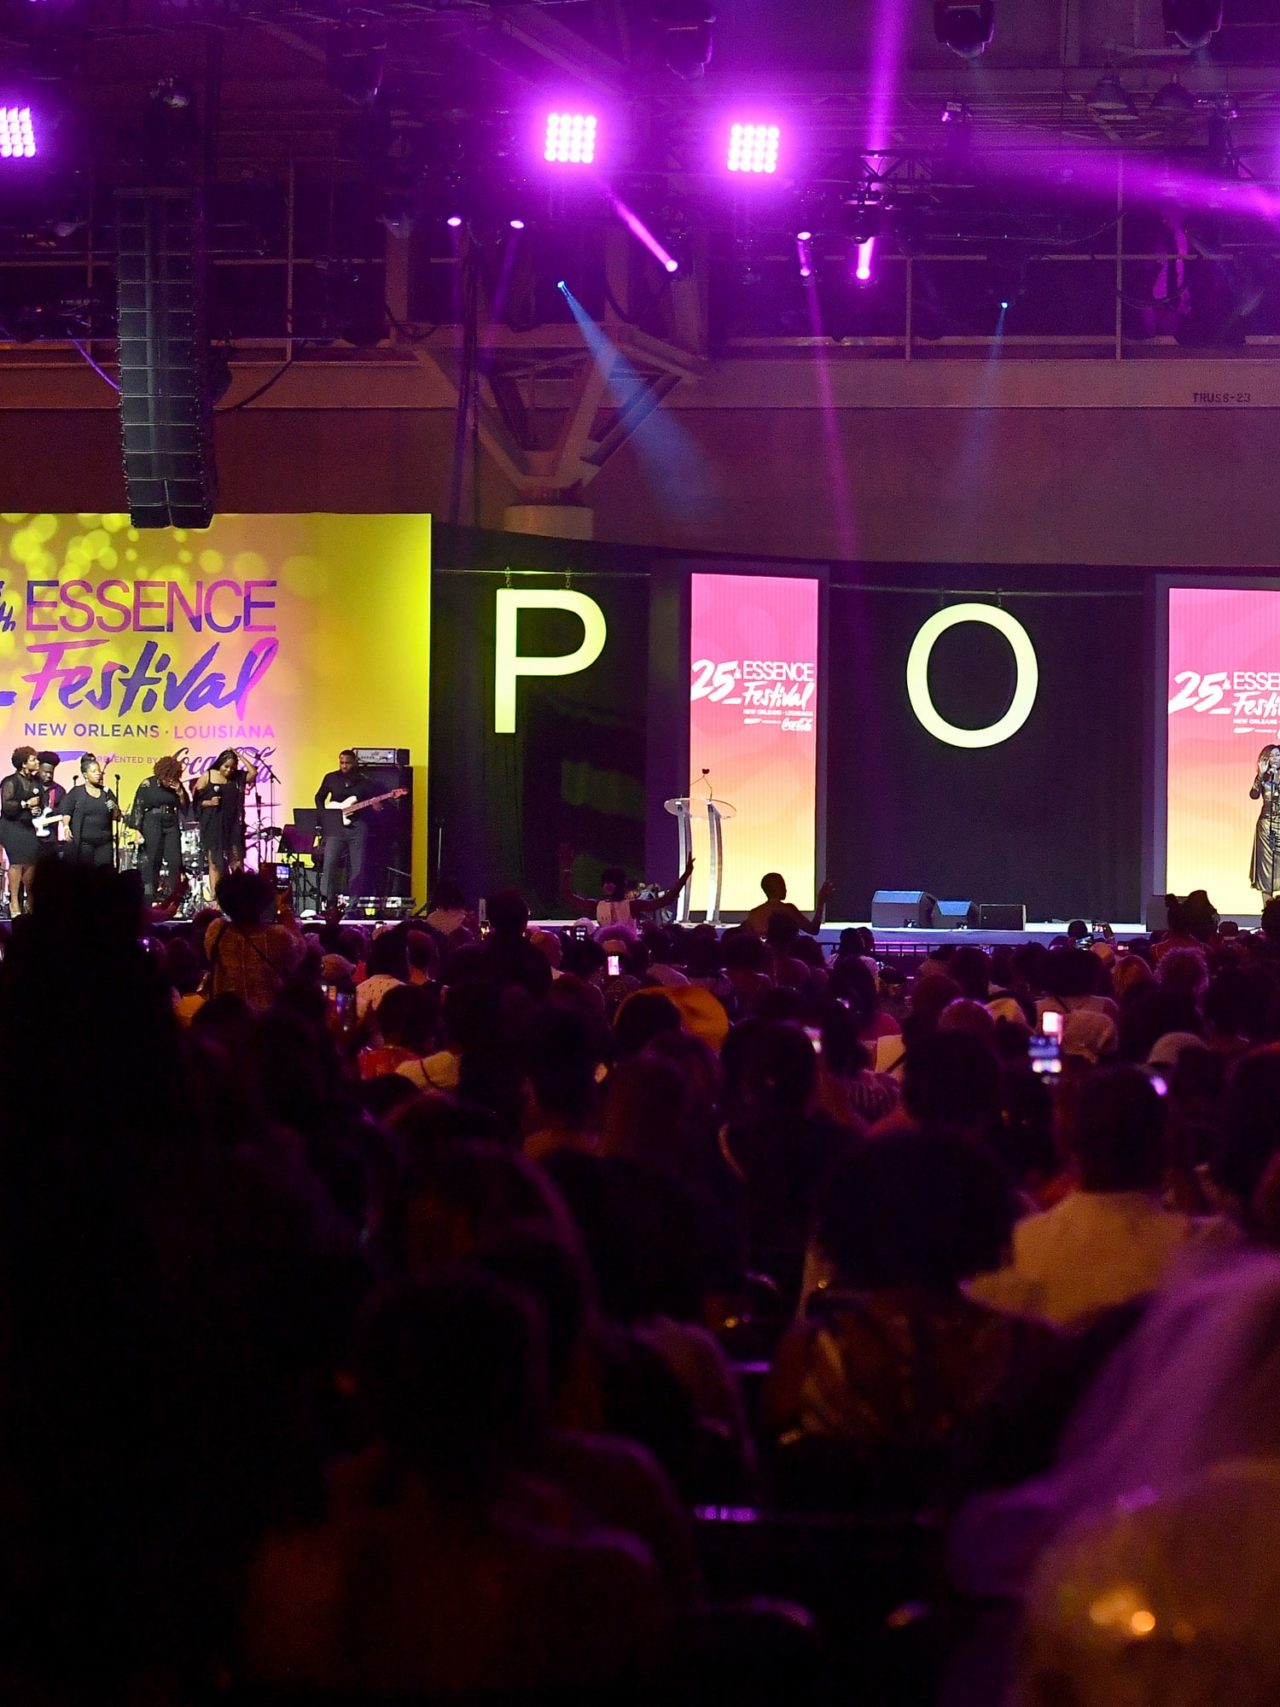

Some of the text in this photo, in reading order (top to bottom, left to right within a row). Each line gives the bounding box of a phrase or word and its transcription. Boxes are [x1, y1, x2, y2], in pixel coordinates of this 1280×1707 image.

[27, 580, 277, 633] ESSENCE
[22, 637, 280, 721] Festival
[743, 660, 814, 681] ESSENCE
[742, 681, 815, 711] Festival
[24, 723, 276, 739] NEW ORLEANS LOUISIANA
